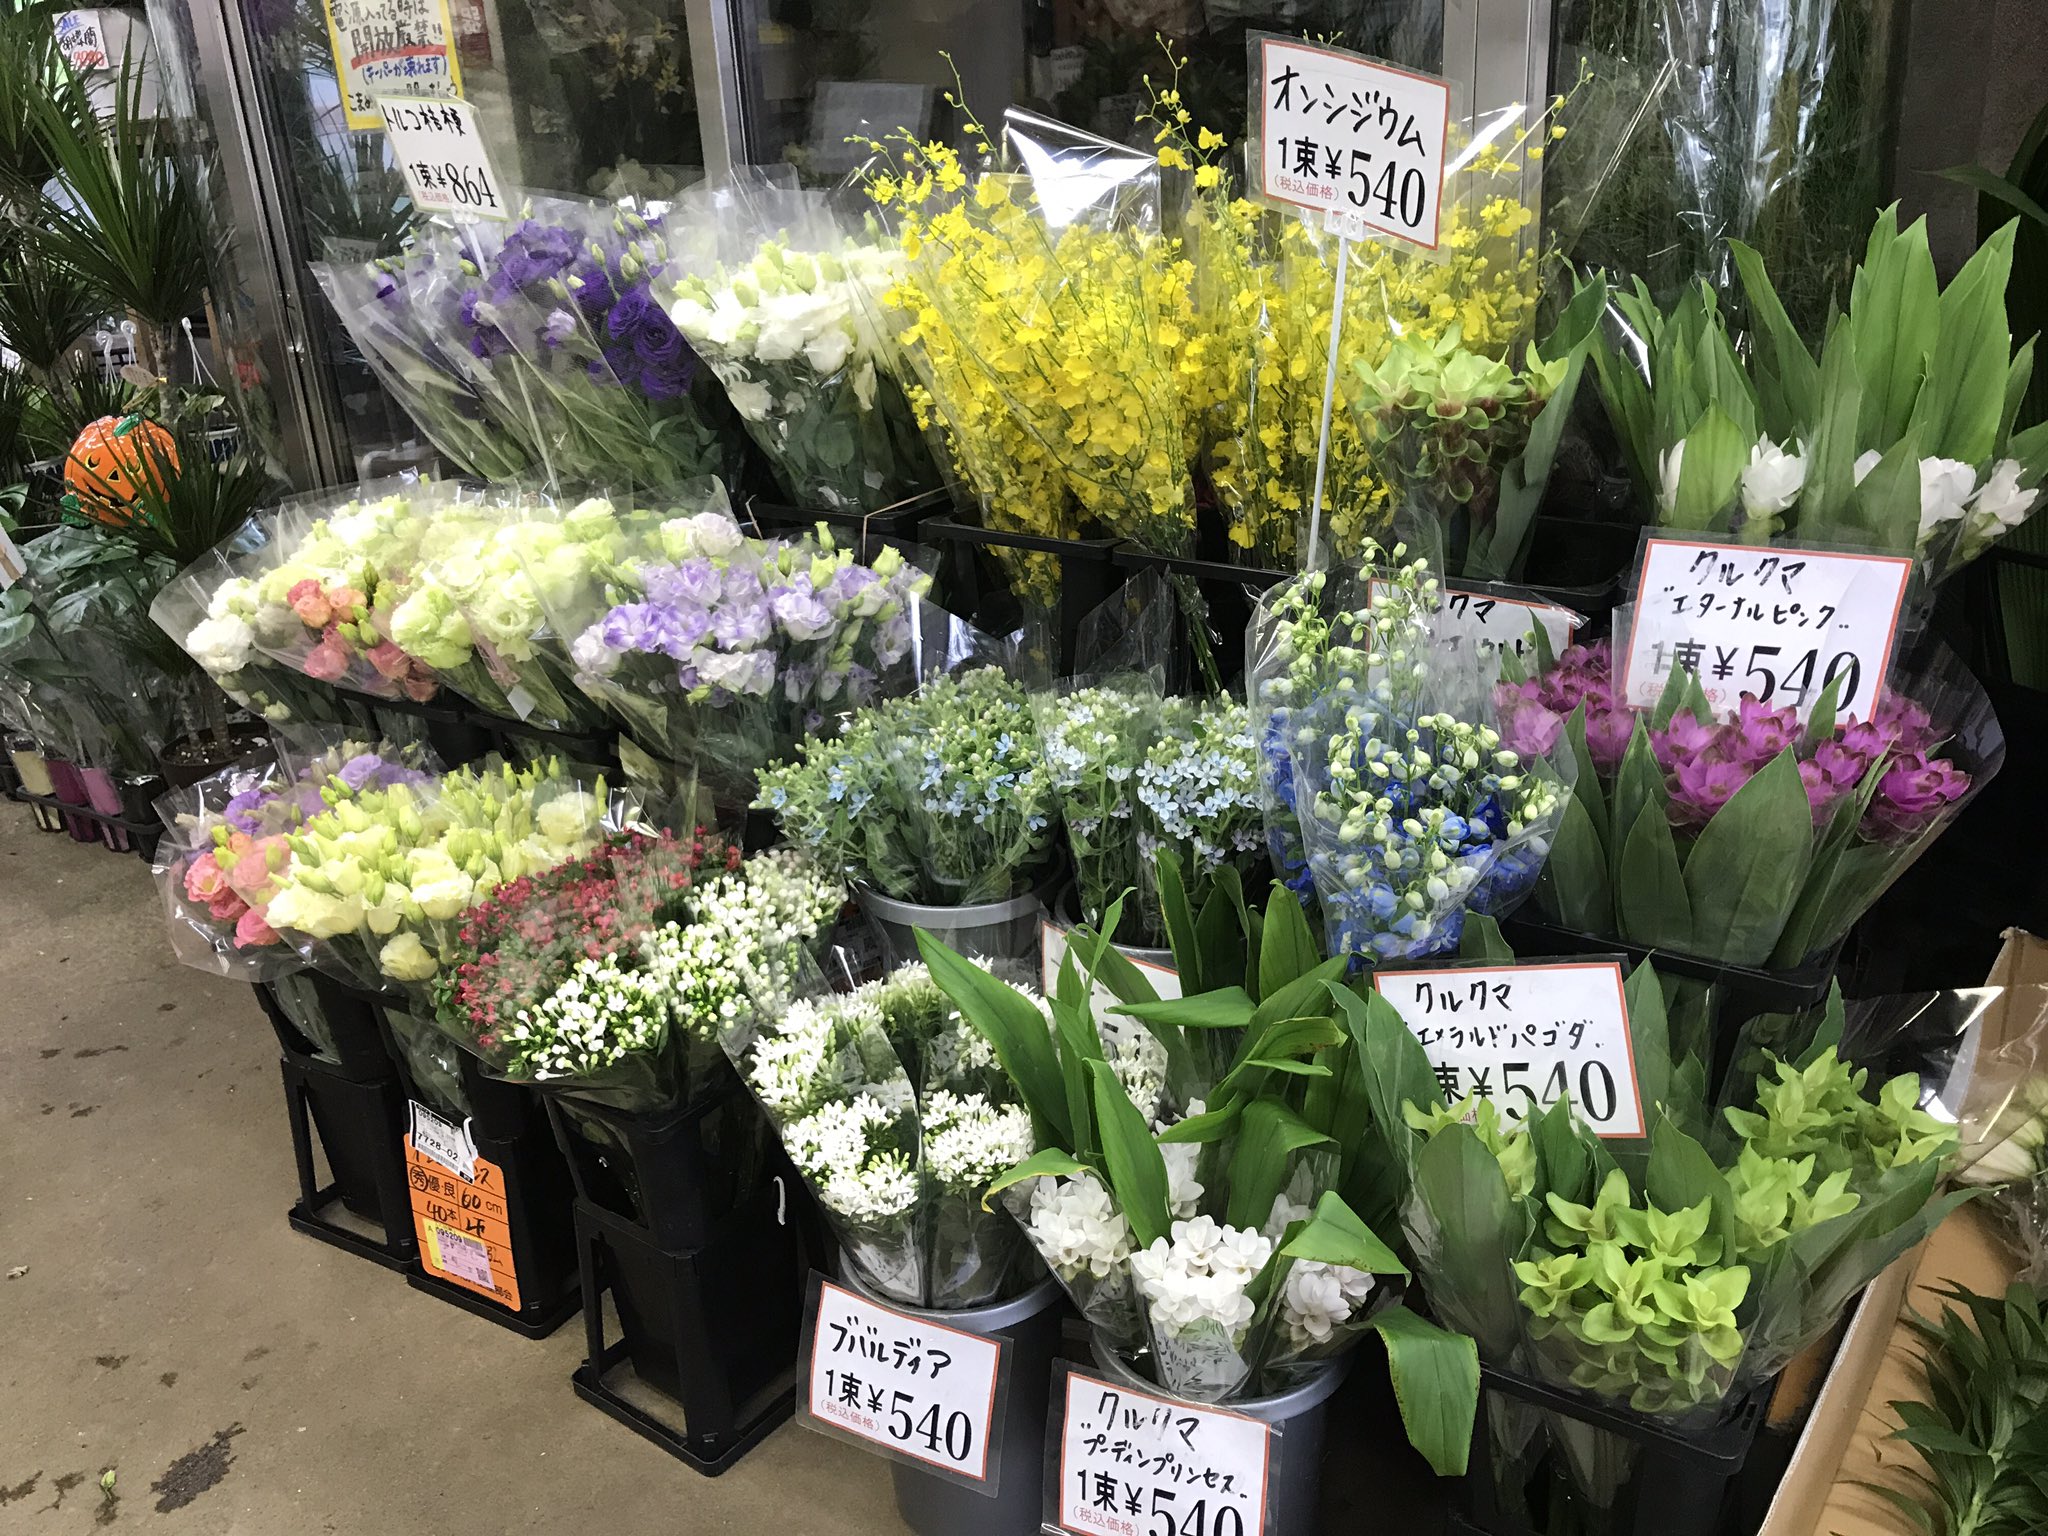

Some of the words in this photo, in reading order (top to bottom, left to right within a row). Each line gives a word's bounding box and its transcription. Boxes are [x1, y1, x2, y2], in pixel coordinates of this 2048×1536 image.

[381, 103, 466, 136] トルコ桔梗
[1271, 65, 1425, 157] オンシジウム
[1689, 551, 1806, 595] クルクマ
[1416, 980, 1512, 1013] クルクマ
[417, 1131, 459, 1161] 7728-02
[829, 1316, 952, 1379] ブバルディア
